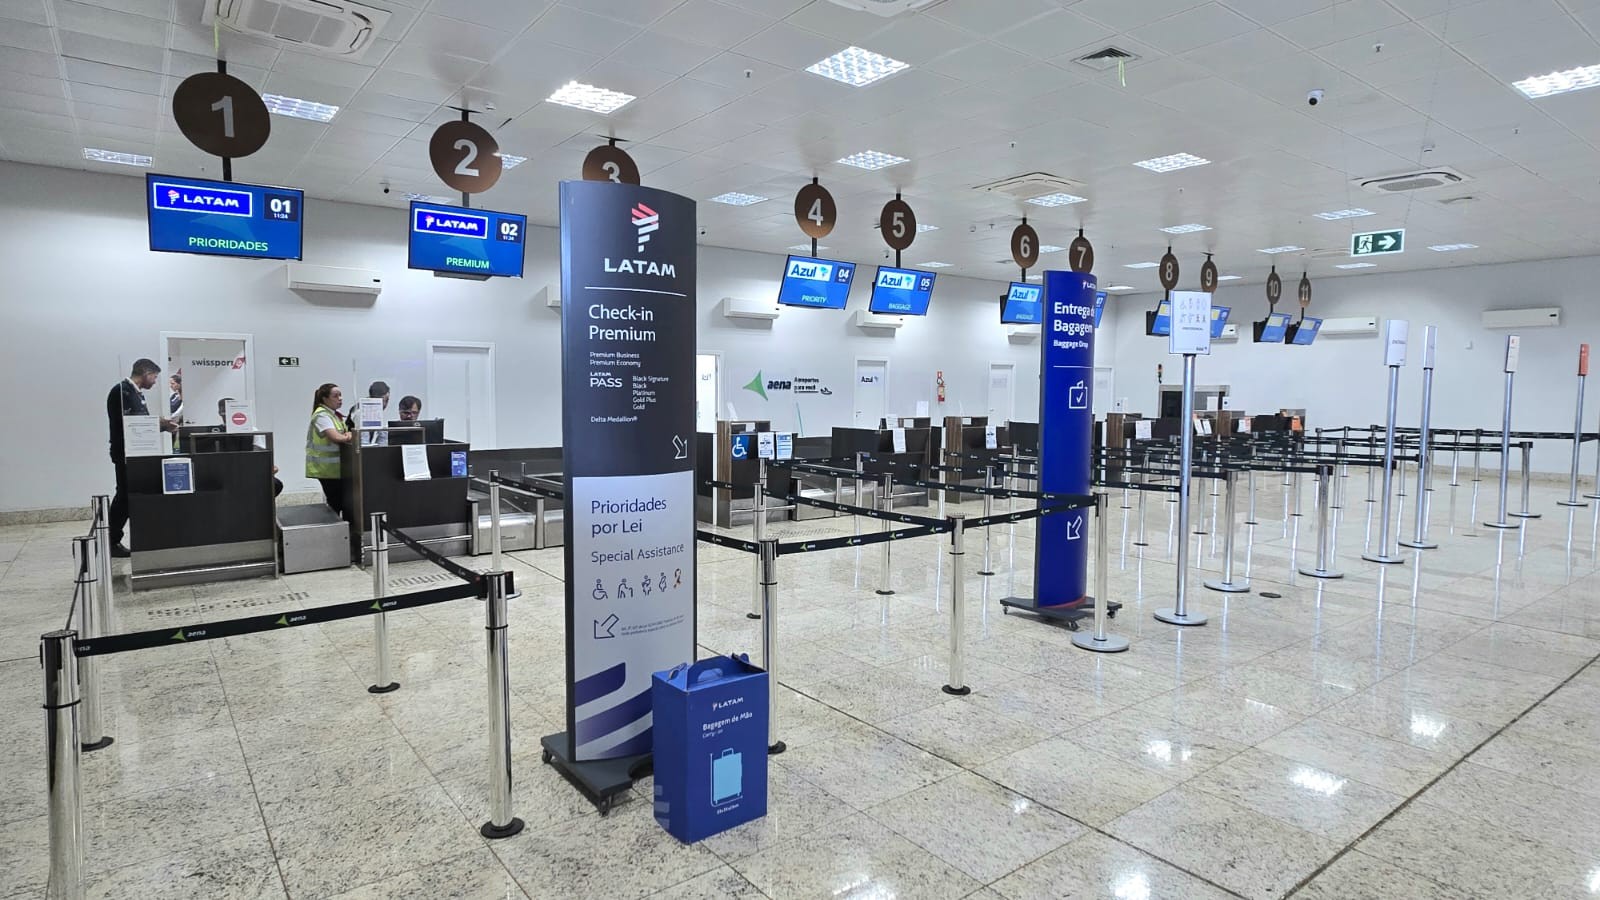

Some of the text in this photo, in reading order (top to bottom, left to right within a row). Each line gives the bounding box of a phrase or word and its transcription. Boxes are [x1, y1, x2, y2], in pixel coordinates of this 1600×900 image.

[211, 95, 235, 138] 1
[452, 138, 480, 177] 2
[602, 161, 622, 184] 3
[183, 194, 240, 208] LATAM
[270, 198, 291, 214] 01
[807, 198, 824, 227] 4
[436, 218, 479, 231] LATAM
[500, 222, 518, 236] 02
[892, 212, 906, 239] 5
[188, 236, 269, 252] PRIORIDADES
[1020, 235, 1031, 258] 6
[446, 256, 490, 269] PREMIUM
[1077, 246, 1087, 268] 7
[604, 257, 676, 278] LATAM
[790, 263, 817, 278] Azul
[838, 268, 849, 279] 04
[1165, 262, 1173, 281] 8
[880, 274, 903, 286] Azul
[920, 278, 930, 287] 05
[1205, 268, 1213, 287] 9
[1011, 289, 1029, 300] Azul
[1268, 279, 1279, 297] 10
[1301, 285, 1309, 302] 11
[801, 294, 827, 304] PRIORITY
[588, 303, 654, 321] Check-in
[1054, 302, 1090, 319] Entrega
[588, 325, 656, 342] Premium
[1053, 339, 1089, 350] Baggage Drop
[616, 360, 641, 368] Economy
[590, 377, 623, 388] PASS
[648, 376, 669, 384] Signature
[767, 379, 792, 390] aena
[591, 496, 667, 514] Prioridades
[591, 519, 643, 538] por Lei
[591, 543, 684, 565] Special Assistance
[382, 600, 398, 608] aena
[289, 615, 307, 623] aena
[187, 629, 206, 638] aena
[718, 696, 744, 708] LATAM
[702, 711, 753, 731] Bagagem de Mão
